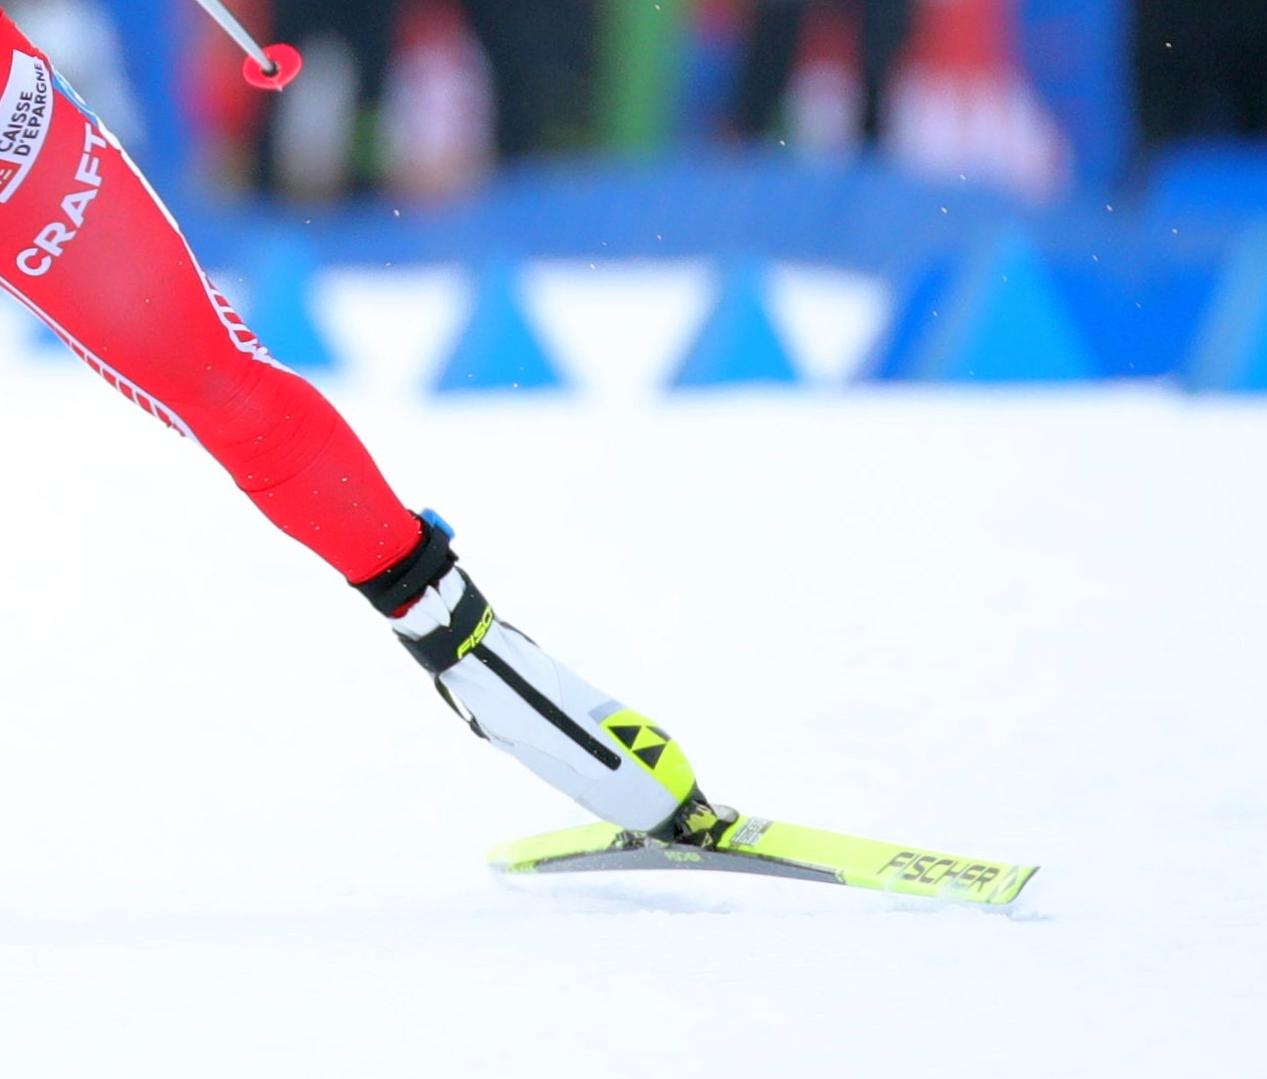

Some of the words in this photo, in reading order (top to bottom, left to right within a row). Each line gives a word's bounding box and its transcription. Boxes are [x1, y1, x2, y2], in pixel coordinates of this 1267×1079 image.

[16, 122, 108, 277] CRAFT
[457, 604, 493, 660] FISC
[875, 851, 1001, 893] FISCHER
